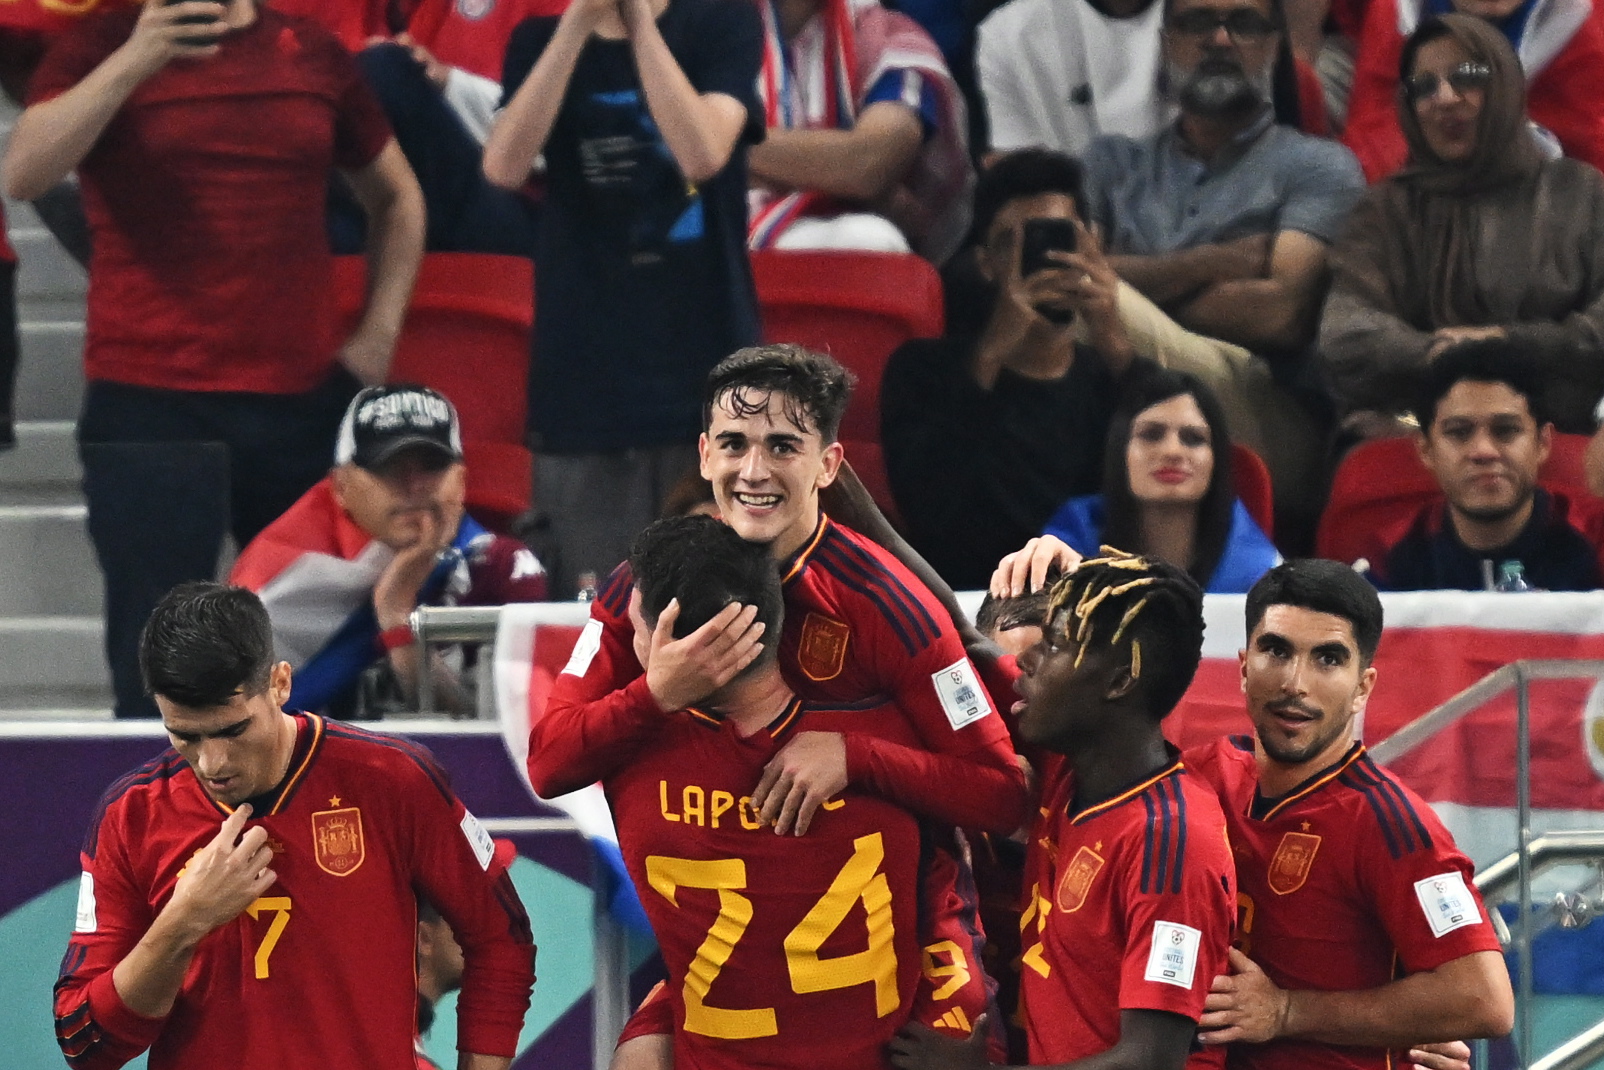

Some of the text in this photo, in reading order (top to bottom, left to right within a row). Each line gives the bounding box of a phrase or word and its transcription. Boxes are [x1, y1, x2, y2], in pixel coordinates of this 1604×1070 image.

[659, 779, 846, 830] LAPO
[245, 896, 292, 980] 7
[645, 831, 901, 1040] 24
[923, 939, 971, 1001] 9
